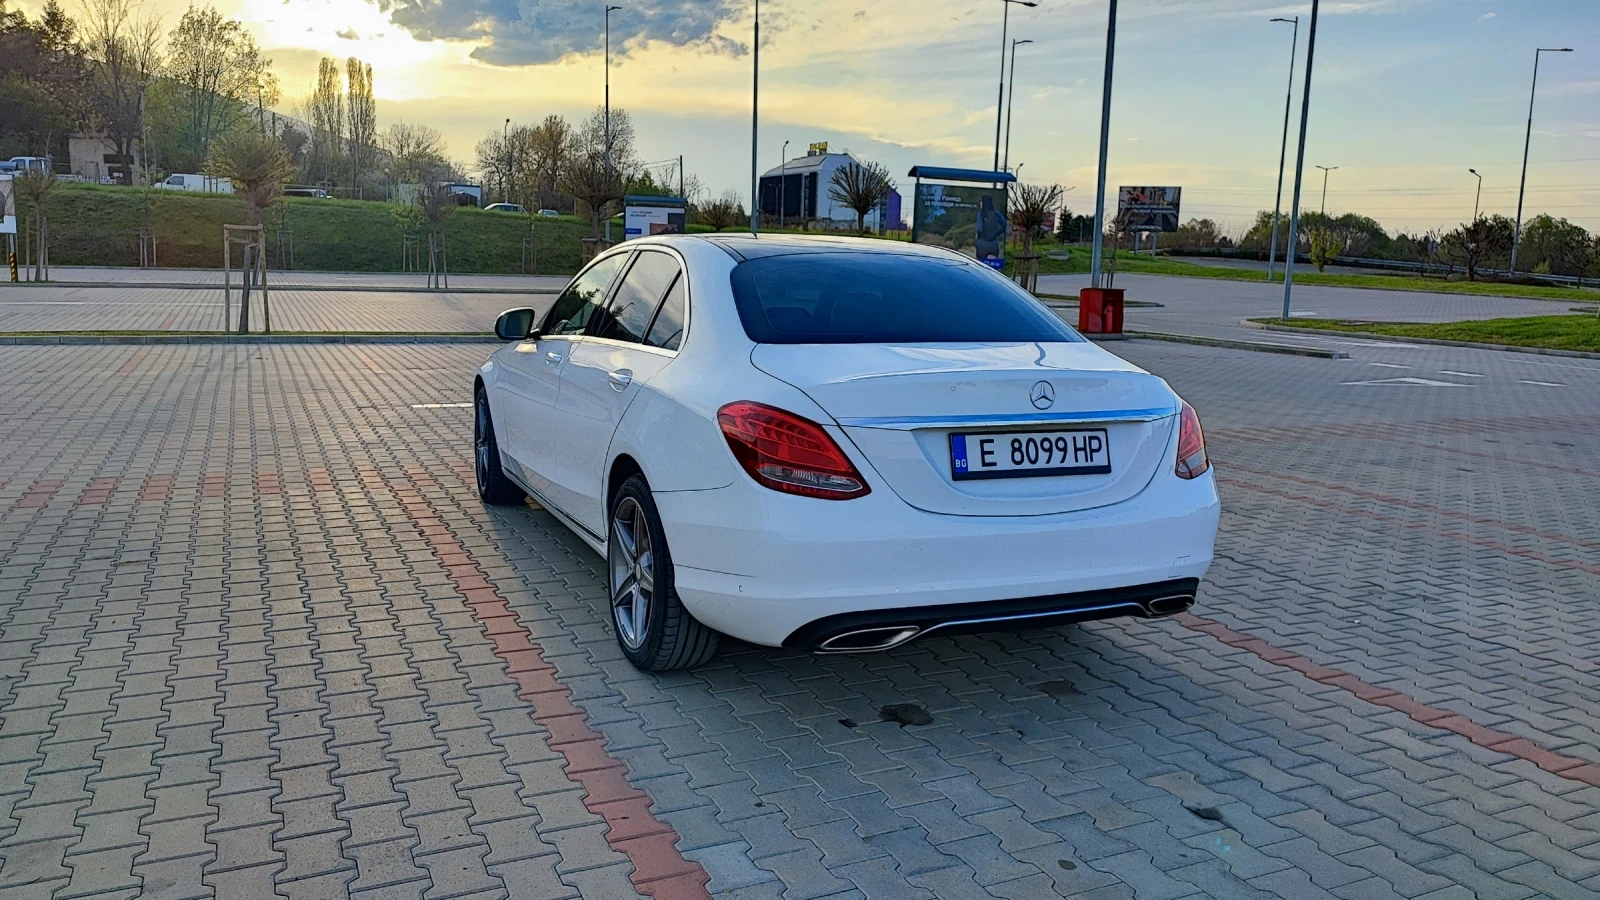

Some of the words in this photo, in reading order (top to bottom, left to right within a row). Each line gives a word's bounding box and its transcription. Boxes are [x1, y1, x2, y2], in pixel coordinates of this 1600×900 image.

[980, 438, 997, 467] E
[1010, 437, 1068, 466] 8099
[1072, 435, 1103, 463] HP
[955, 459, 967, 468] BG
